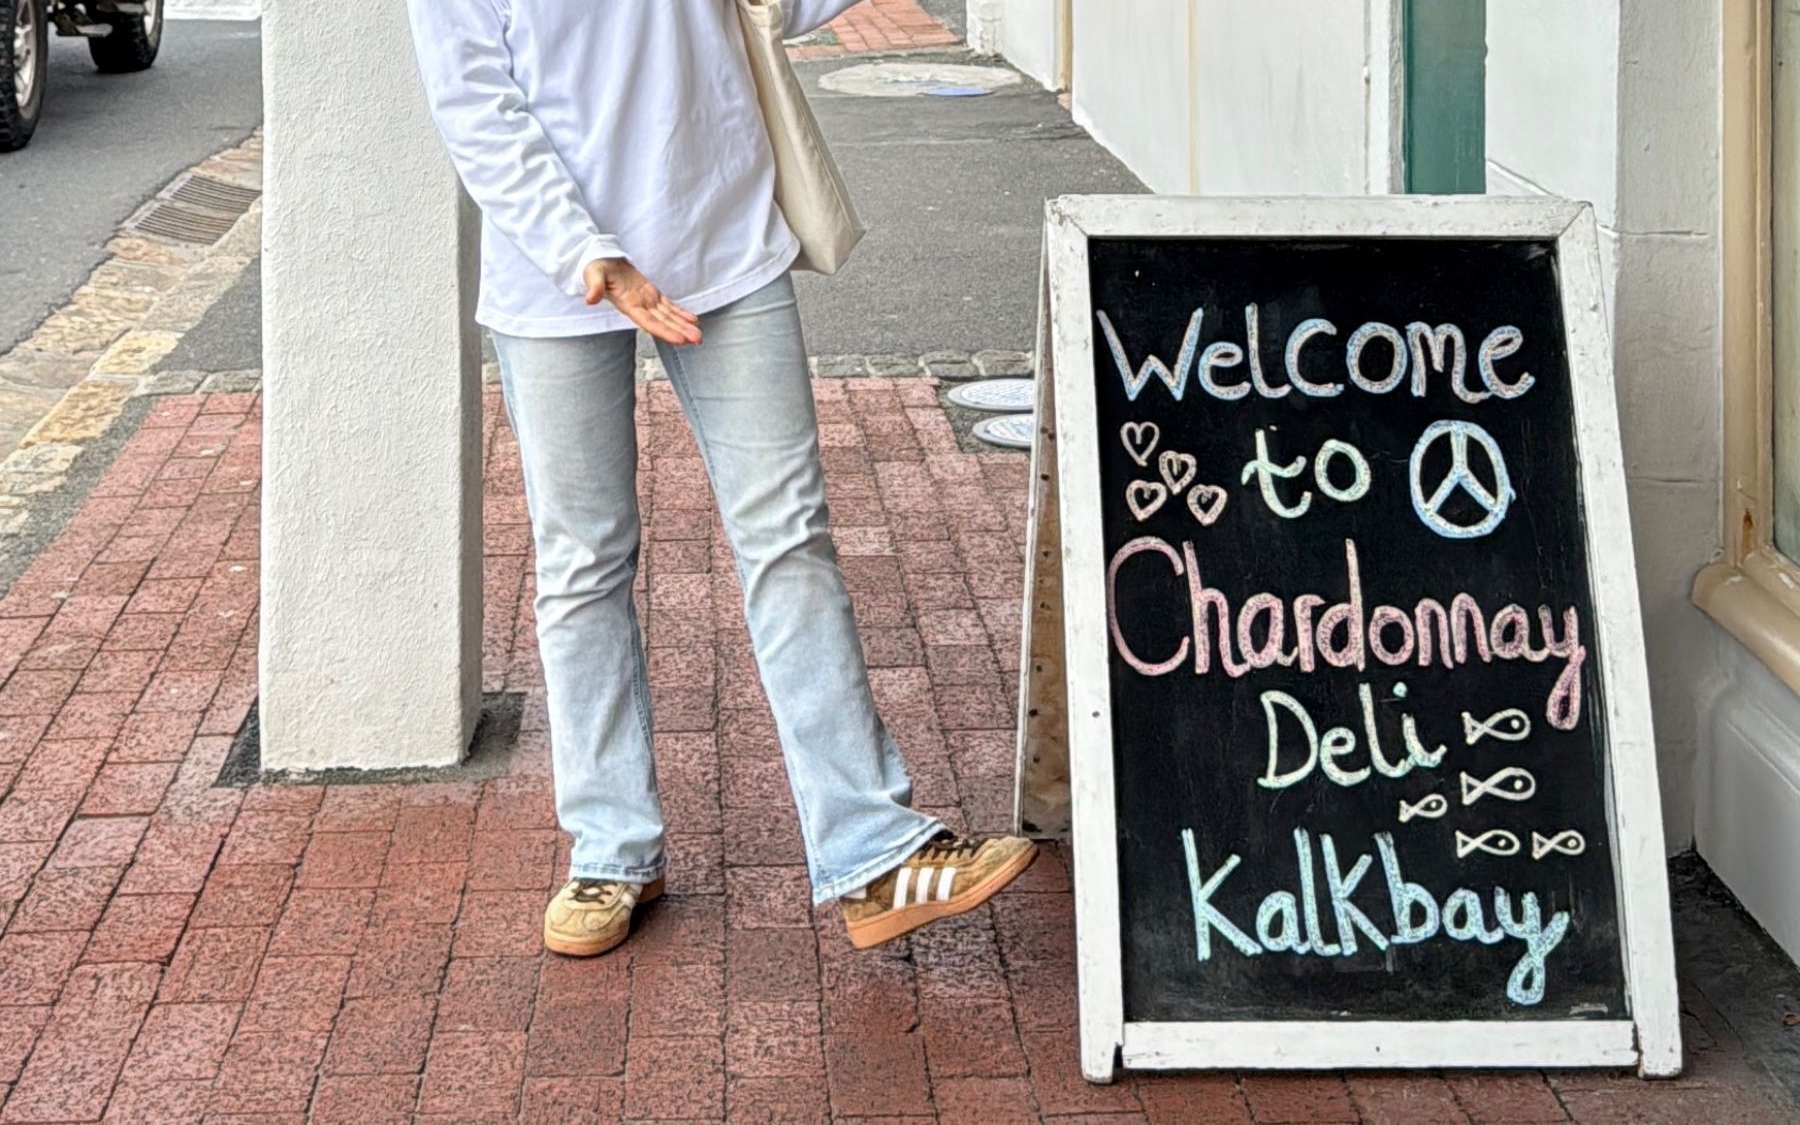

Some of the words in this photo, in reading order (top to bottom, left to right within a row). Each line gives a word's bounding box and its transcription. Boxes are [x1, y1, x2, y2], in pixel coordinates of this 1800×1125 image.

[1096, 302, 1535, 404] Welcome
[1241, 427, 1371, 520] to
[1106, 535, 1586, 731] Chardonnay
[1257, 681, 1447, 789] Deli
